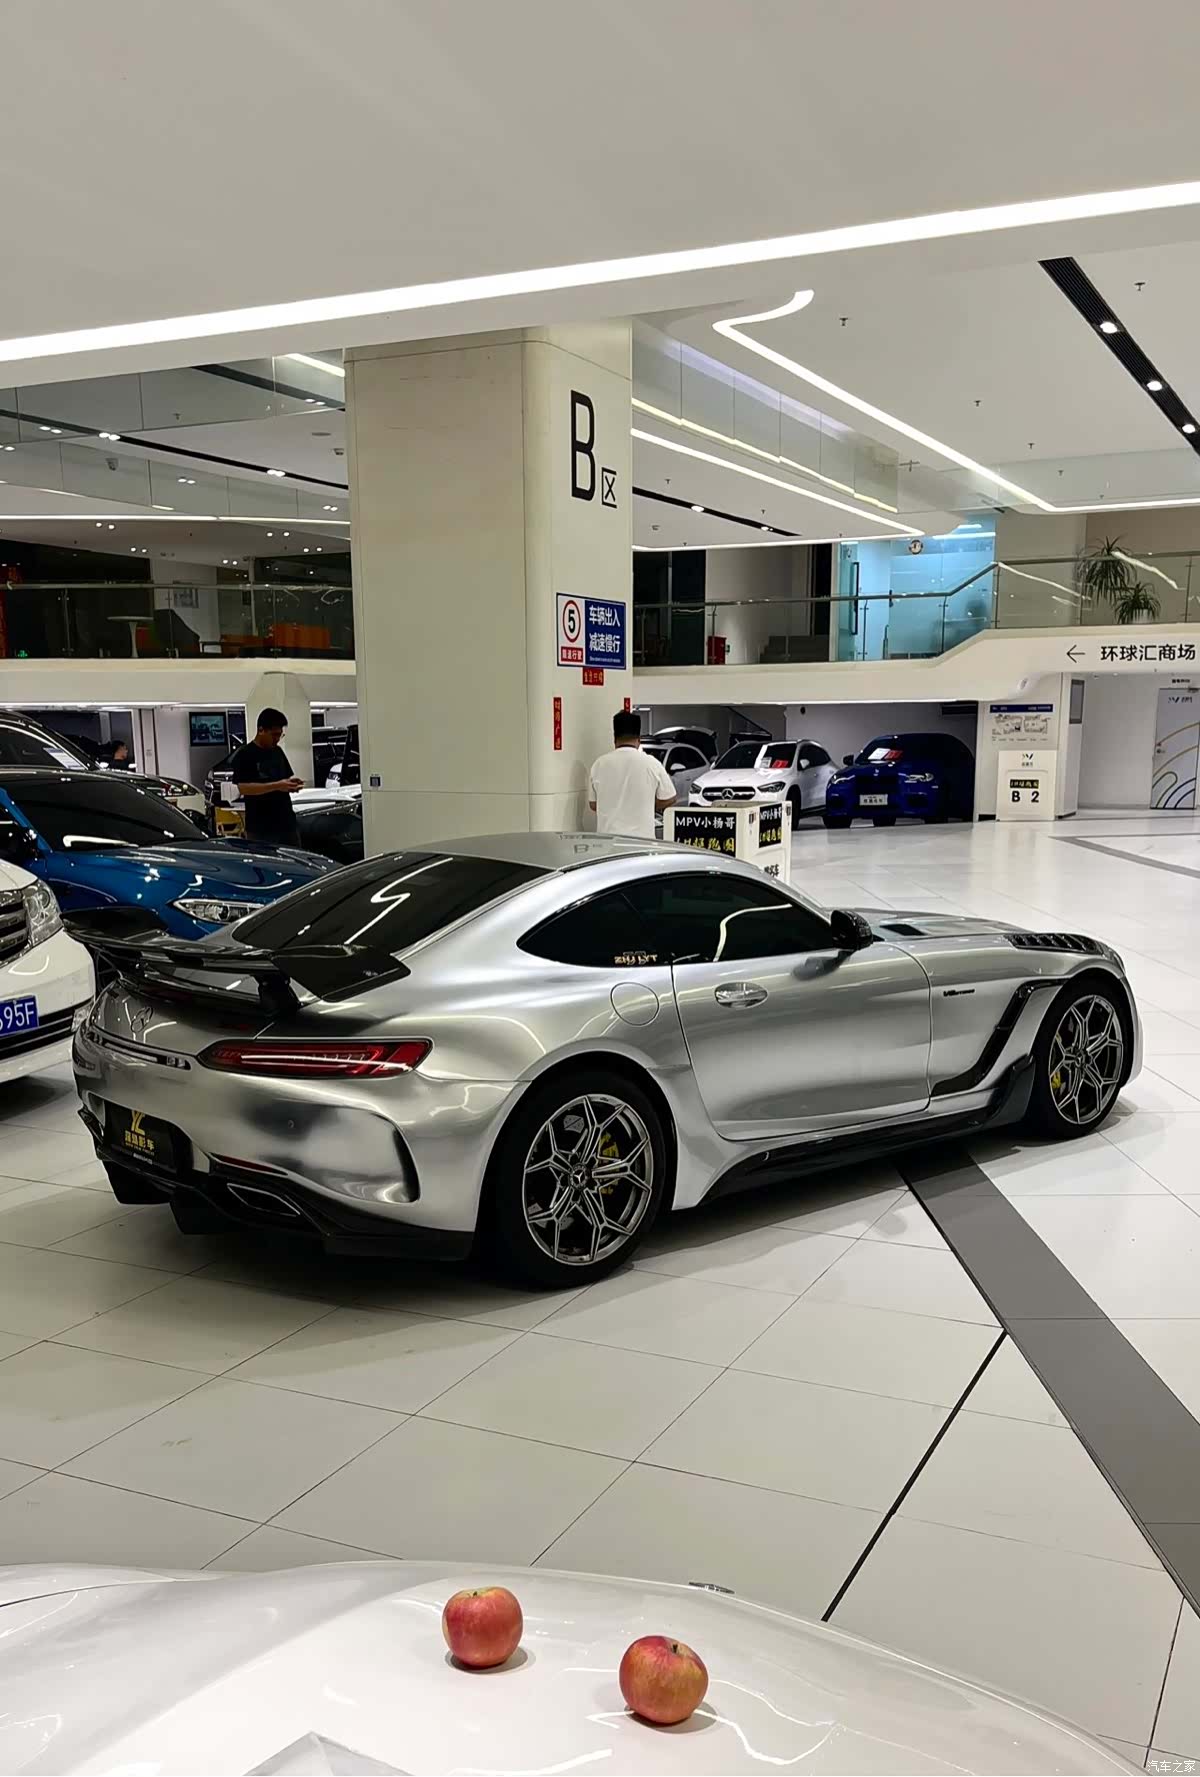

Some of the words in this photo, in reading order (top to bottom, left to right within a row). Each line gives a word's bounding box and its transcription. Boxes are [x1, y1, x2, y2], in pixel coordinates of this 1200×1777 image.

[568, 608, 576, 634] 5
[588, 604, 621, 628] 车辆出入
[588, 632, 621, 654] 减速慢行
[1100, 643, 1196, 662] 环球汇商场
[1011, 790, 1021, 803] B
[1031, 790, 1040, 803] 2
[676, 815, 736, 830] MPV小杨哥
